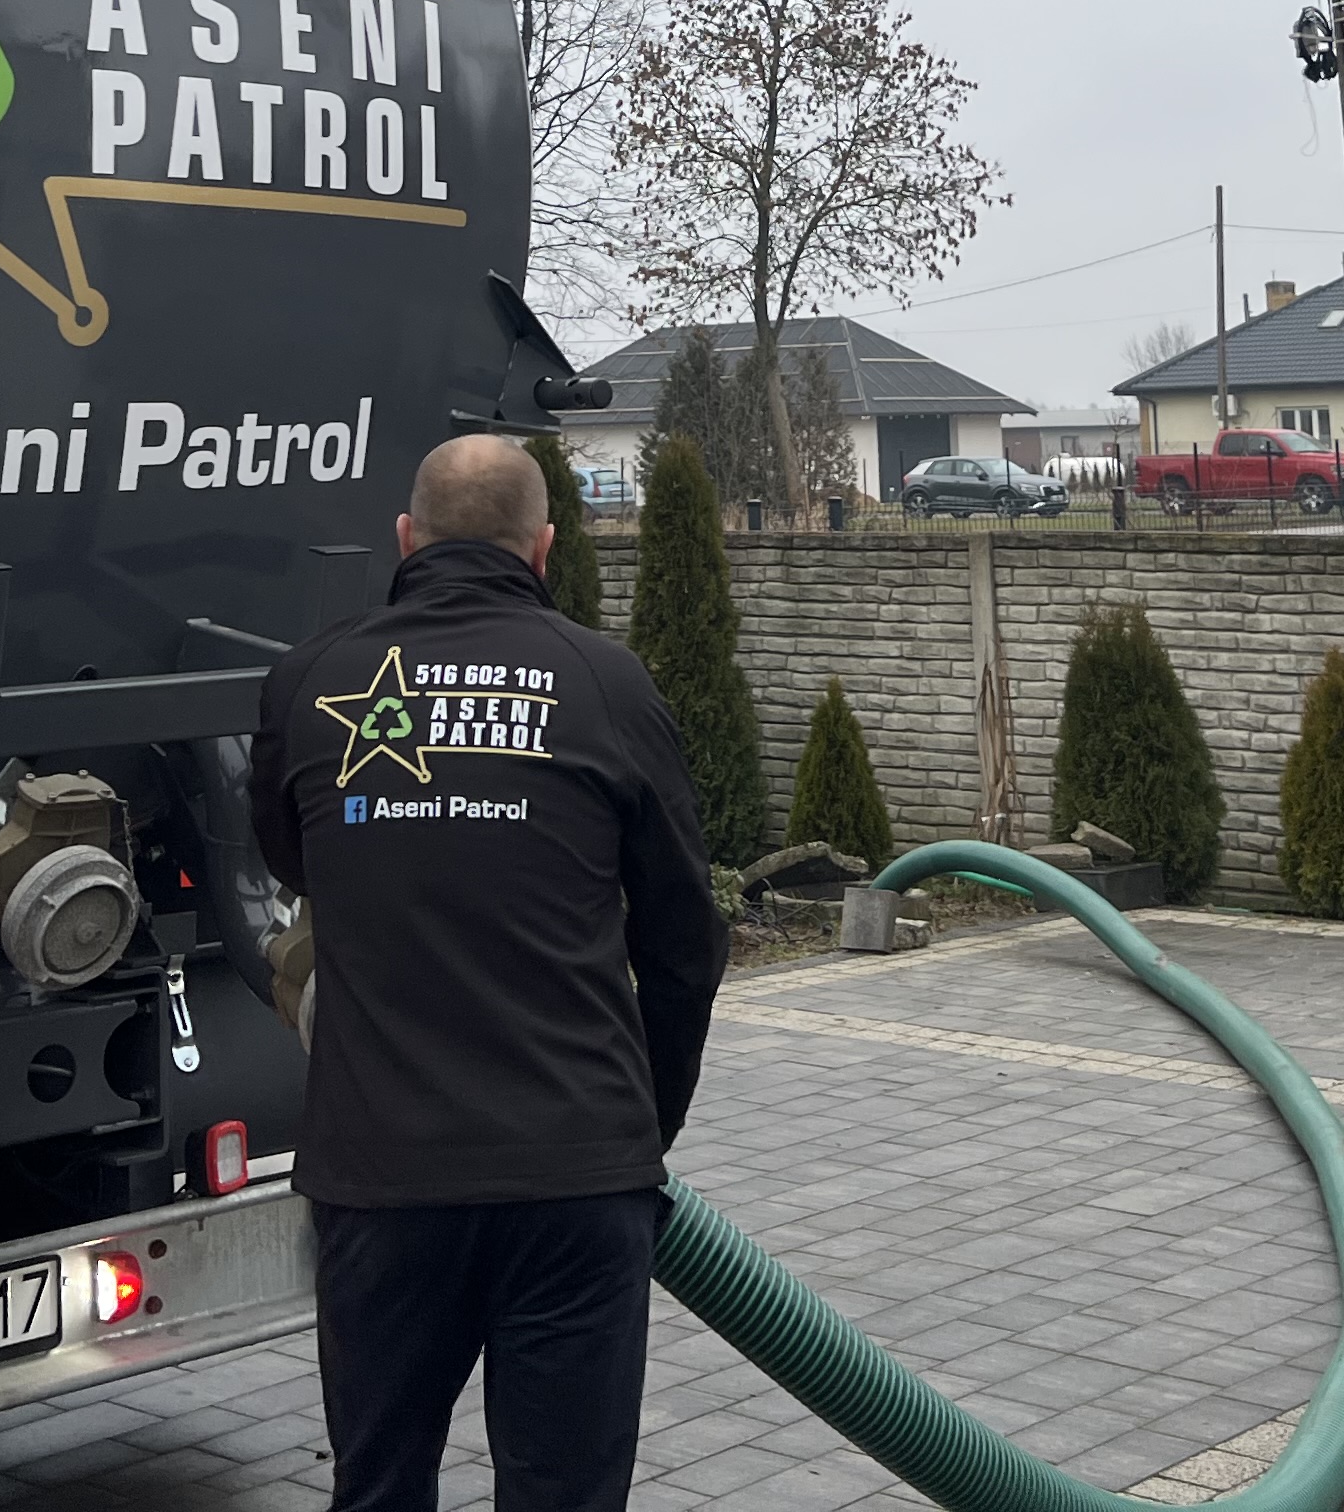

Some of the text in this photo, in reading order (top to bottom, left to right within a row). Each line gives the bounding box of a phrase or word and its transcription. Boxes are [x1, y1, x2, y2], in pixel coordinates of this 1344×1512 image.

[91, 68, 448, 201] PATROL
[118, 396, 373, 492] Patrol
[415, 664, 554, 692] 516 602 101
[430, 697, 550, 727] ASENI
[428, 721, 545, 752] PATROL
[372, 796, 442, 820] Aseni
[449, 795, 528, 821] Patrol
